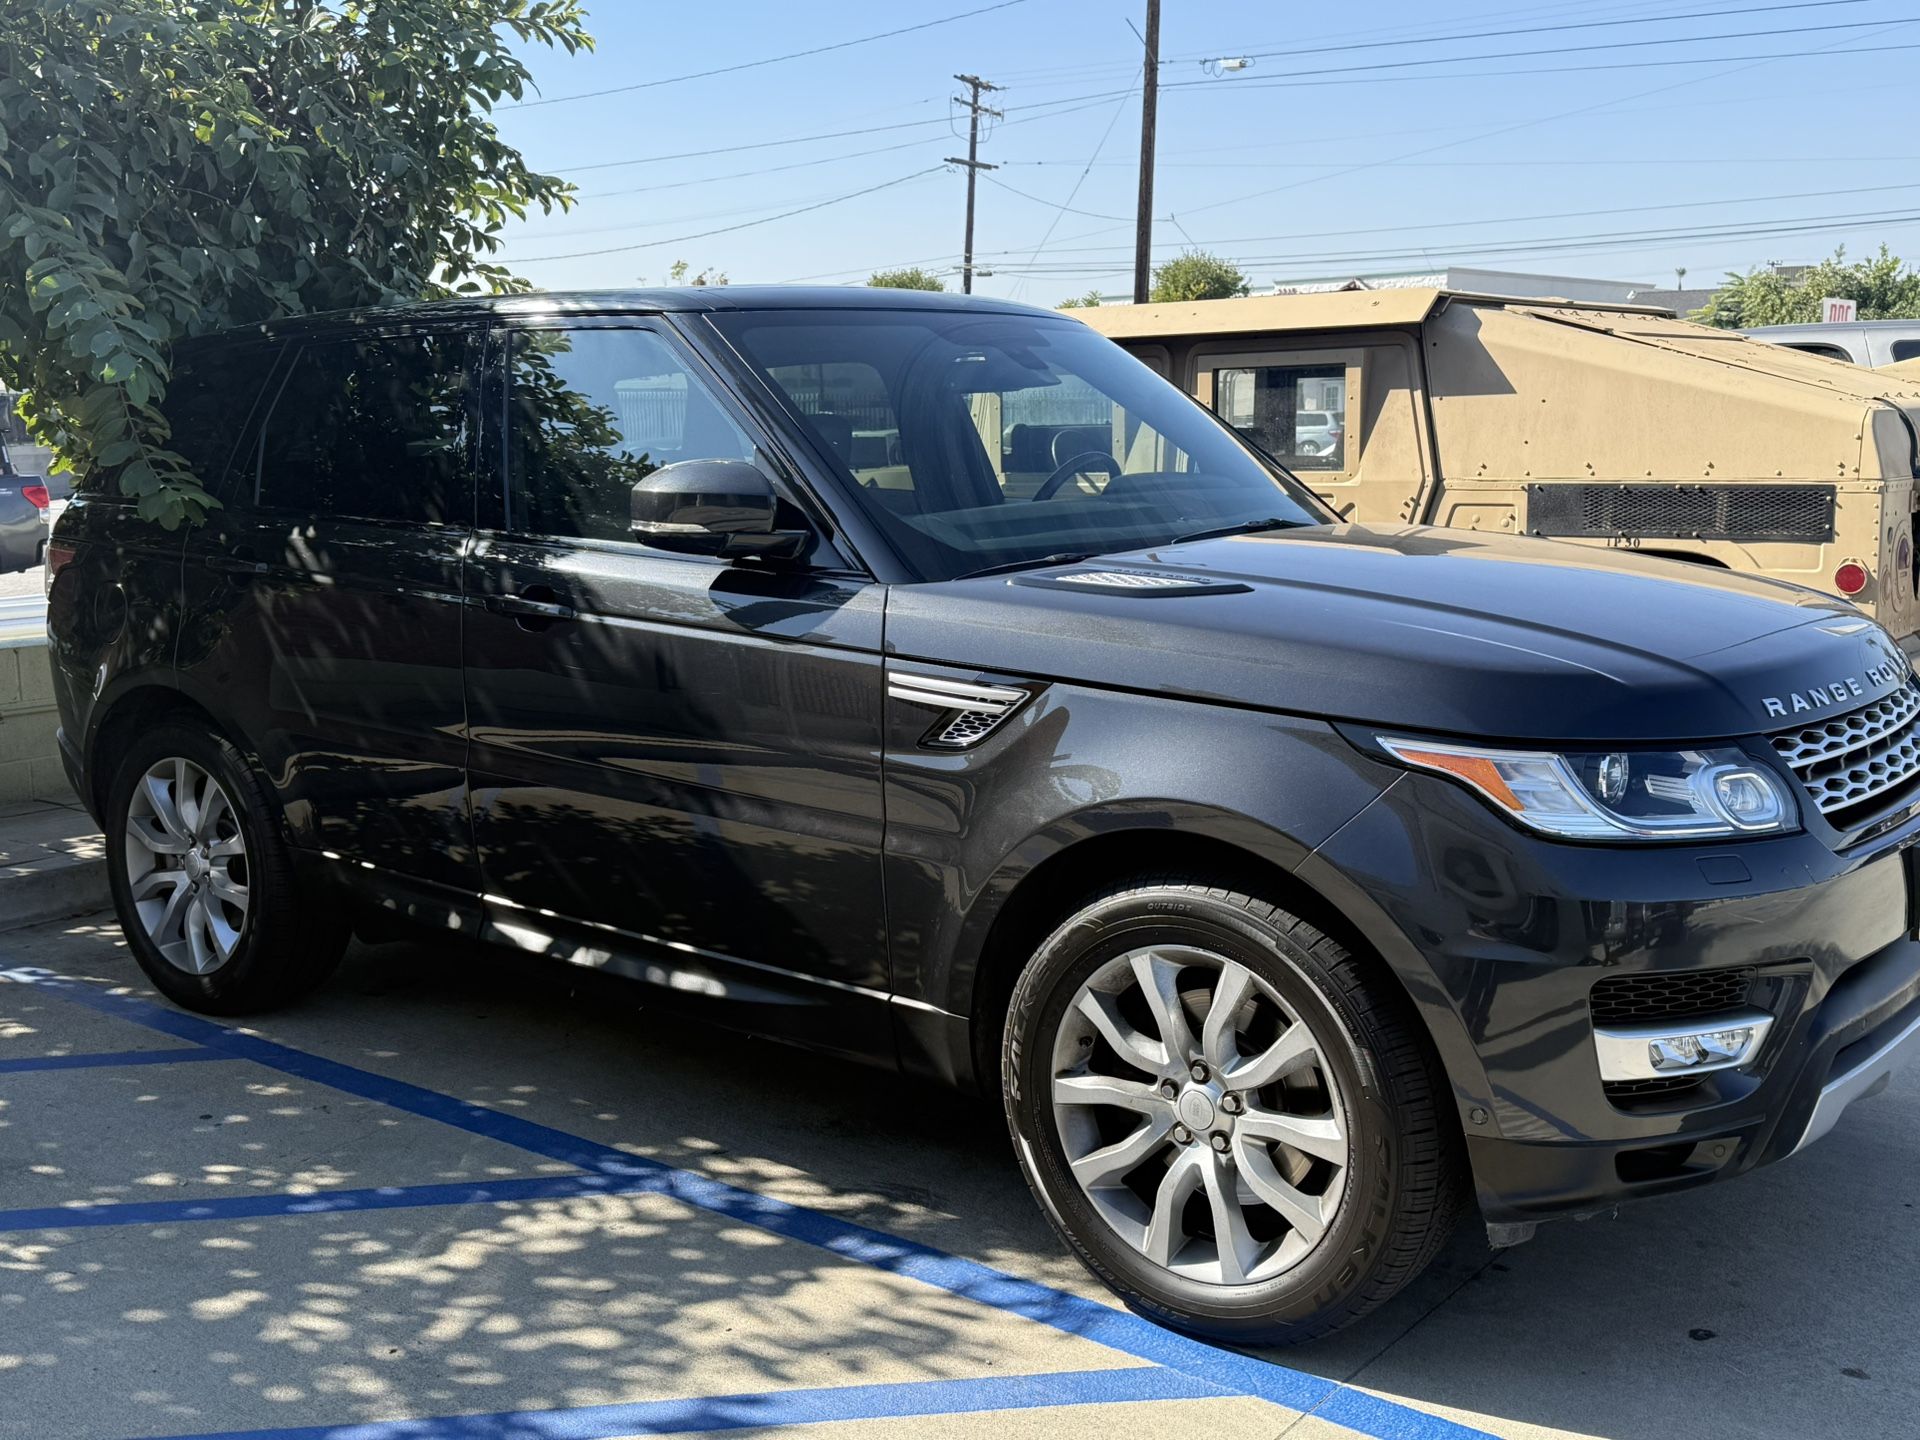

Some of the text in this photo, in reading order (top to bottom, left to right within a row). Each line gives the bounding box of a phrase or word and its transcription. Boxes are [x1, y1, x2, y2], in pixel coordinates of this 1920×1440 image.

[1761, 651, 1909, 718] RANGE ROVE
[1313, 1135, 1391, 1310] FALKEN
